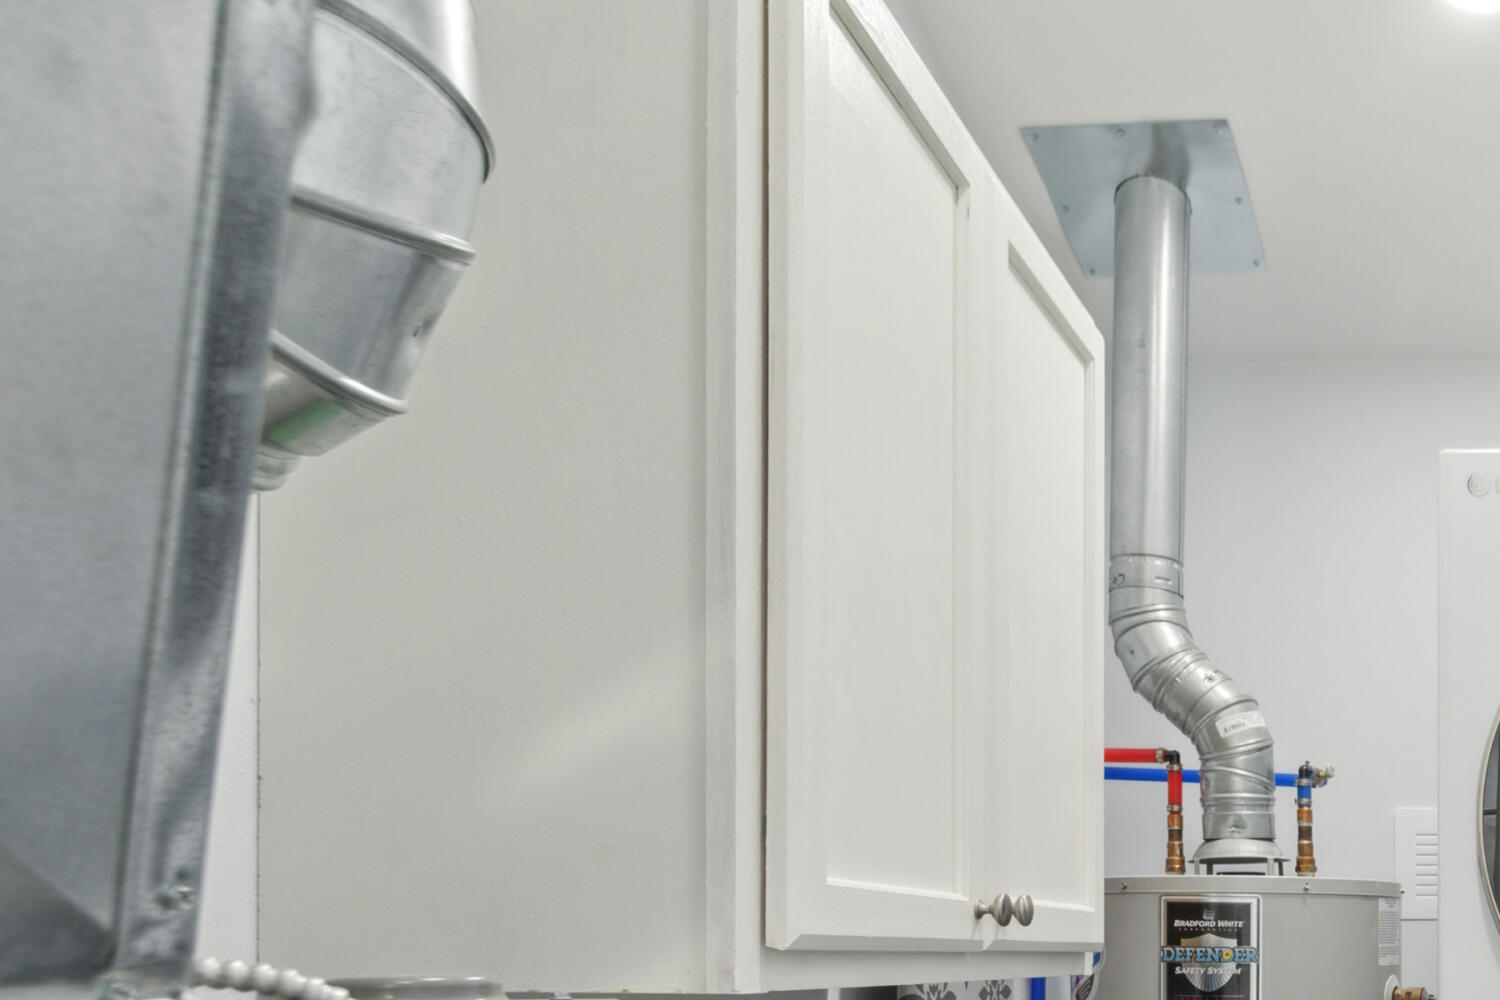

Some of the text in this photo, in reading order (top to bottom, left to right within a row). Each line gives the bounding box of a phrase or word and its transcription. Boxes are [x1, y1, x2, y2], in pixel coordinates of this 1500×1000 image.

[1174, 919, 1243, 928] BRADFORD WHITE
[1160, 946, 1258, 963] DEFENDER
